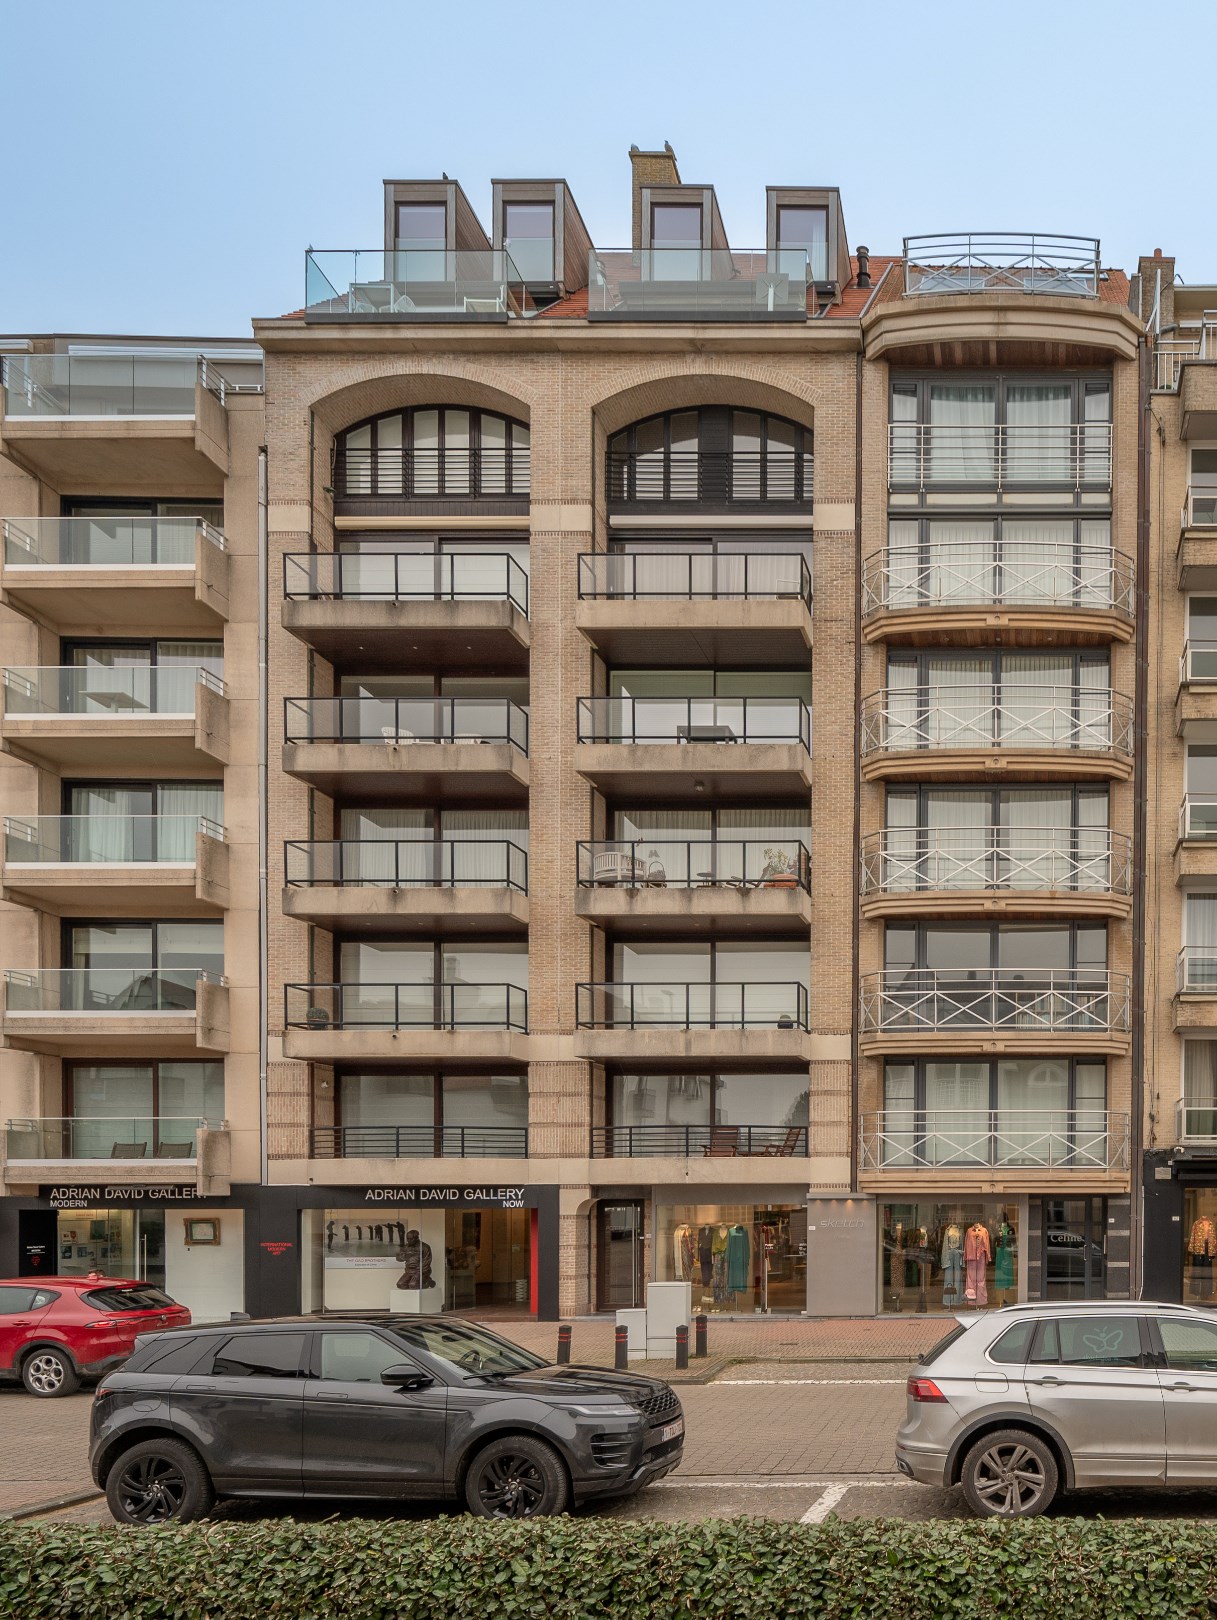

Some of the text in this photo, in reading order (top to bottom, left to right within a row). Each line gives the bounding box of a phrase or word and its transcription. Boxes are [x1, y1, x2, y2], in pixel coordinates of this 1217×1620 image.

[50, 1188, 207, 1199] ADRIAN DAVID GALLER
[365, 1188, 524, 1200] ADRIAN DAVID GALLERY
[502, 1200, 524, 1208] NOW
